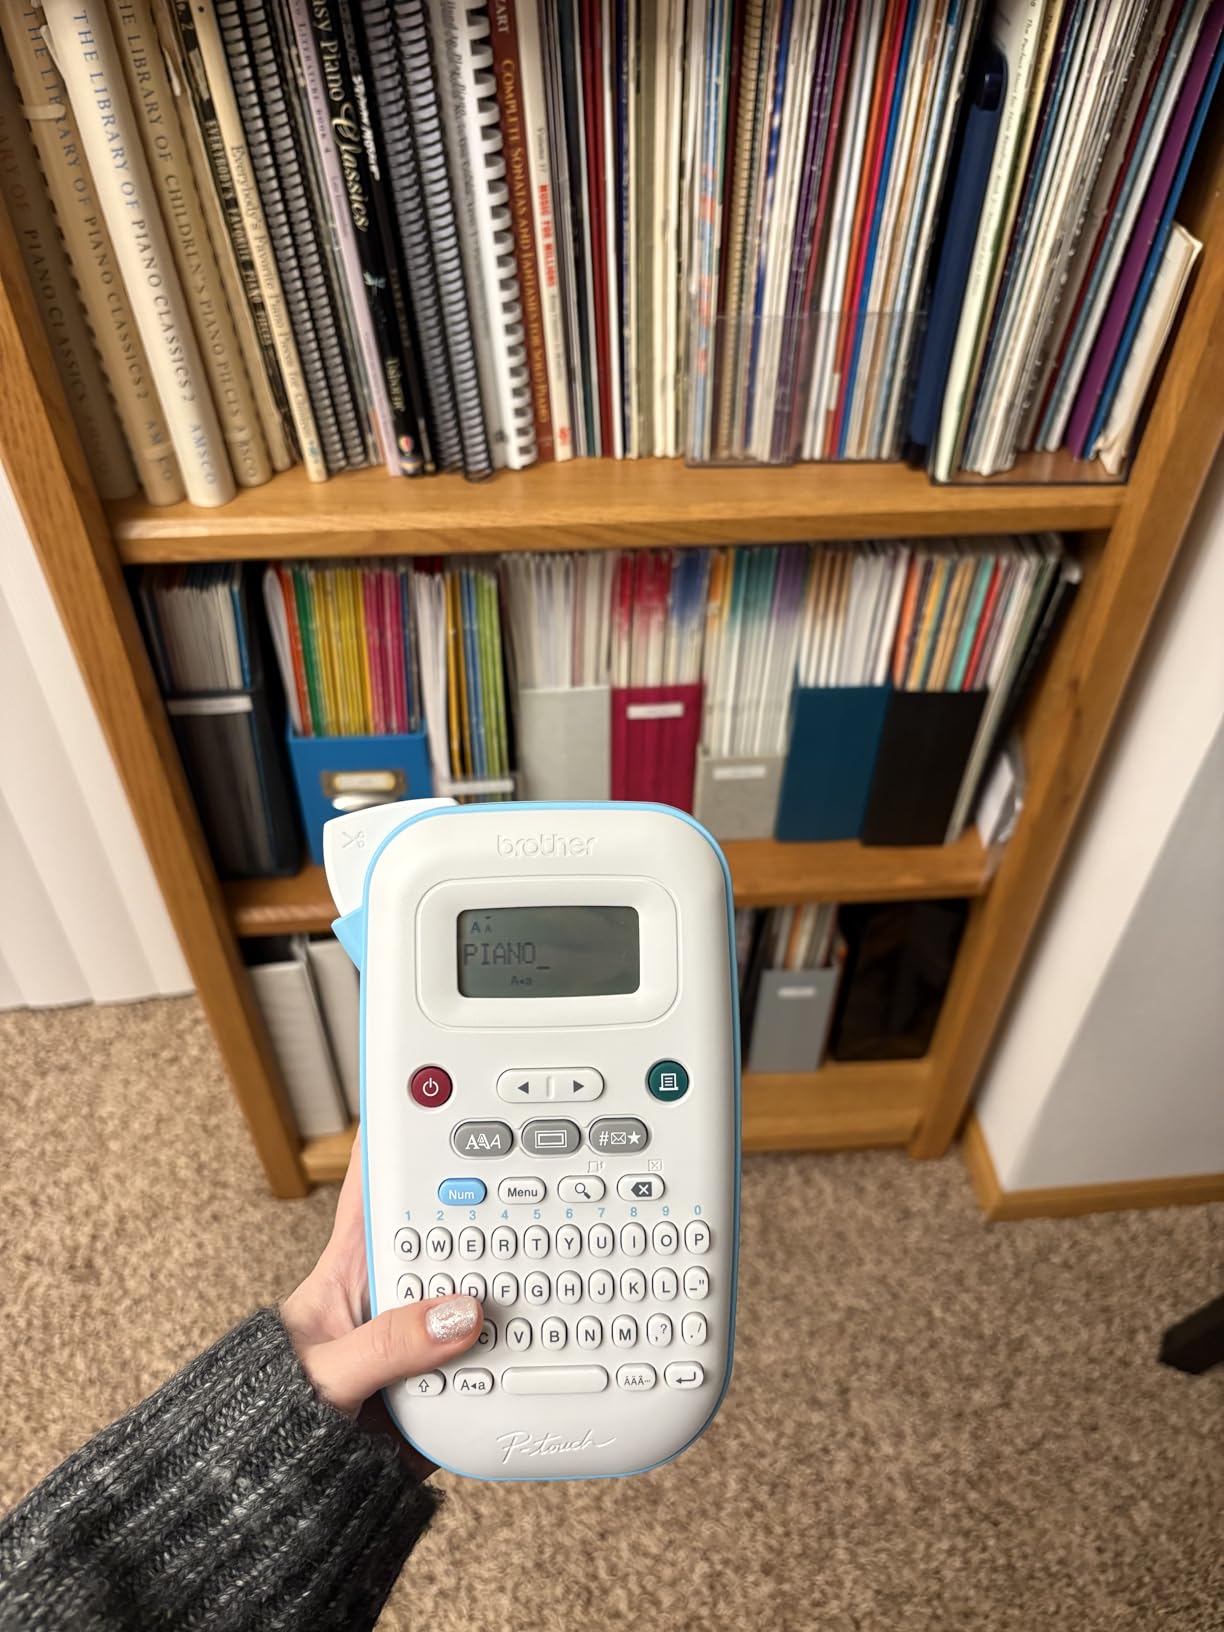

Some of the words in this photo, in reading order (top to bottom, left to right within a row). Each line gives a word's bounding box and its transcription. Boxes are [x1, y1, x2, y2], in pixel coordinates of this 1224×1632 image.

[319, 40, 346, 101] Piano
[501, 59, 520, 141] COMPLETE
[128, 35, 163, 126] LIBRARY
[153, 136, 174, 161] OF
[164, 175, 208, 295] CHILDREN'S
[200, 300, 224, 355] PIANO
[332, 103, 369, 233] Classics
[511, 148, 527, 217] SONATAS
[232, 144, 262, 231] Everybody's
[255, 236, 276, 289] Favorite
[516, 218, 531, 249] AND
[24, 229, 56, 300] PIANO
[73, 10, 100, 63] THE
[89, 72, 130, 171] LIBRARY
[121, 182, 140, 209] OF
[131, 218, 162, 288] PIANO
[154, 296, 192, 390] CLASSICS
[191, 424, 216, 485] AMSCO
[73, 178, 90, 206] OF
[84, 216, 113, 286] PIANO
[108, 292, 144, 390] CLASSICS
[496, 833, 597, 857] brother
[405, 1211, 411, 1221] 1
[436, 1211, 444, 1221] 2
[469, 1210, 476, 1220] 3
[501, 1210, 509, 1220] 4
[533, 1209, 541, 1219] 5
[566, 1208, 573, 1219] 6
[598, 1207, 606, 1218] 7
[630, 1206, 637, 1217] 8
[662, 1205, 669, 1216] 9
[694, 1205, 701, 1215] 0
[448, 1189, 475, 1200] Num
[507, 1187, 538, 1198] Menu
[401, 1241, 412, 1253] Q
[432, 1240, 446, 1252] W
[467, 1240, 477, 1252] E
[499, 1240, 509, 1252] R
[532, 1239, 542, 1251] T
[565, 1238, 574, 1250] Y
[596, 1237, 607, 1249] U
[661, 1234, 672, 1247] O
[694, 1233, 704, 1246] P
[404, 1287, 414, 1299] A
[469, 1286, 479, 1297] D
[501, 1286, 510, 1298] F
[532, 1285, 543, 1297] G
[565, 1284, 574, 1296] H
[598, 1283, 606, 1295] J
[629, 1282, 639, 1294] K
[662, 1281, 671, 1293] L
[479, 1332, 489, 1345] C
[513, 1331, 524, 1343] V
[550, 1331, 559, 1343] B
[585, 1329, 595, 1342] N
[619, 1328, 631, 1341] M
[497, 1429, 616, 1464] P-touch
